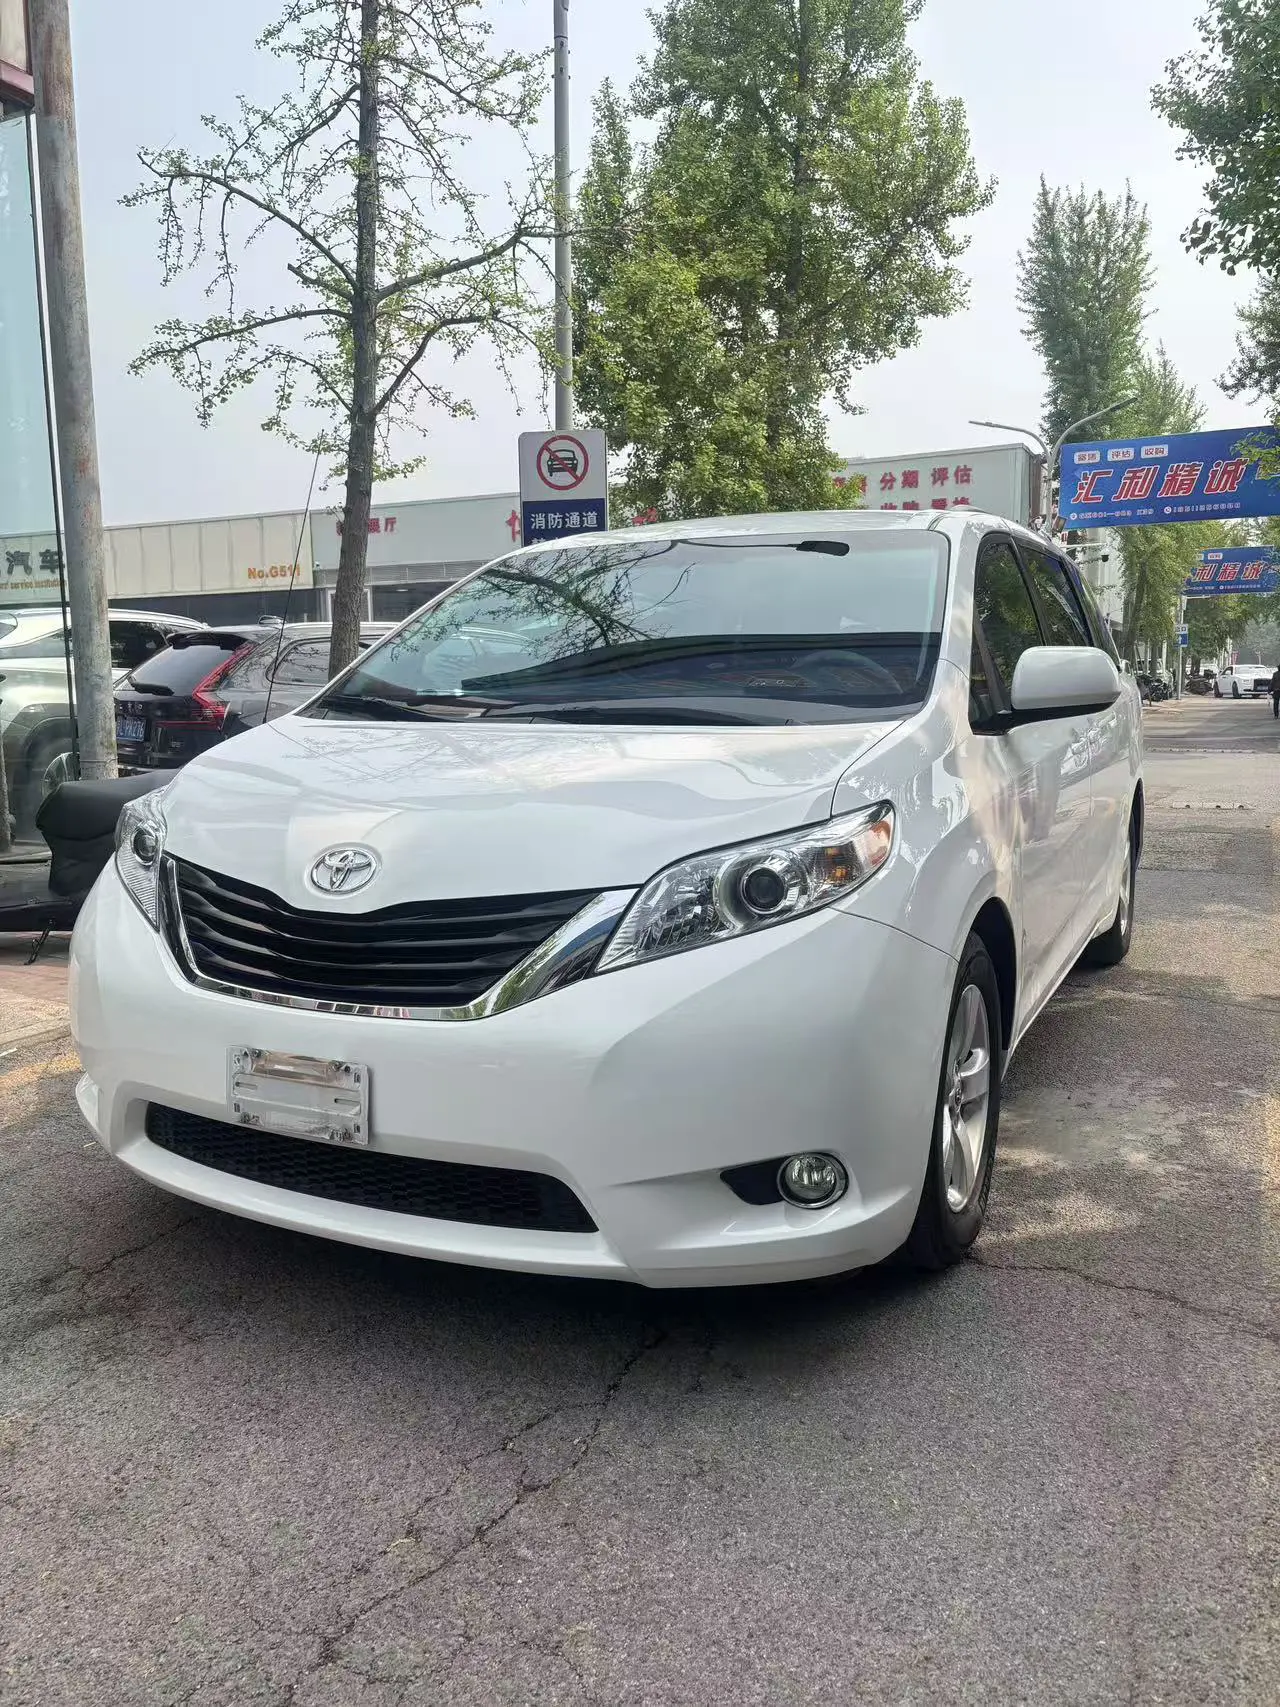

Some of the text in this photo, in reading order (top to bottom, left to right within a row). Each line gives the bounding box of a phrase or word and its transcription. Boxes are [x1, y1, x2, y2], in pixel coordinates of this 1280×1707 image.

[880, 469, 920, 491] 分期
[931, 465, 973, 487] 评估
[1071, 458, 1249, 503] 汇利精诚
[530, 512, 598, 530] 消防通道
[0, 549, 66, 576] 汽车
